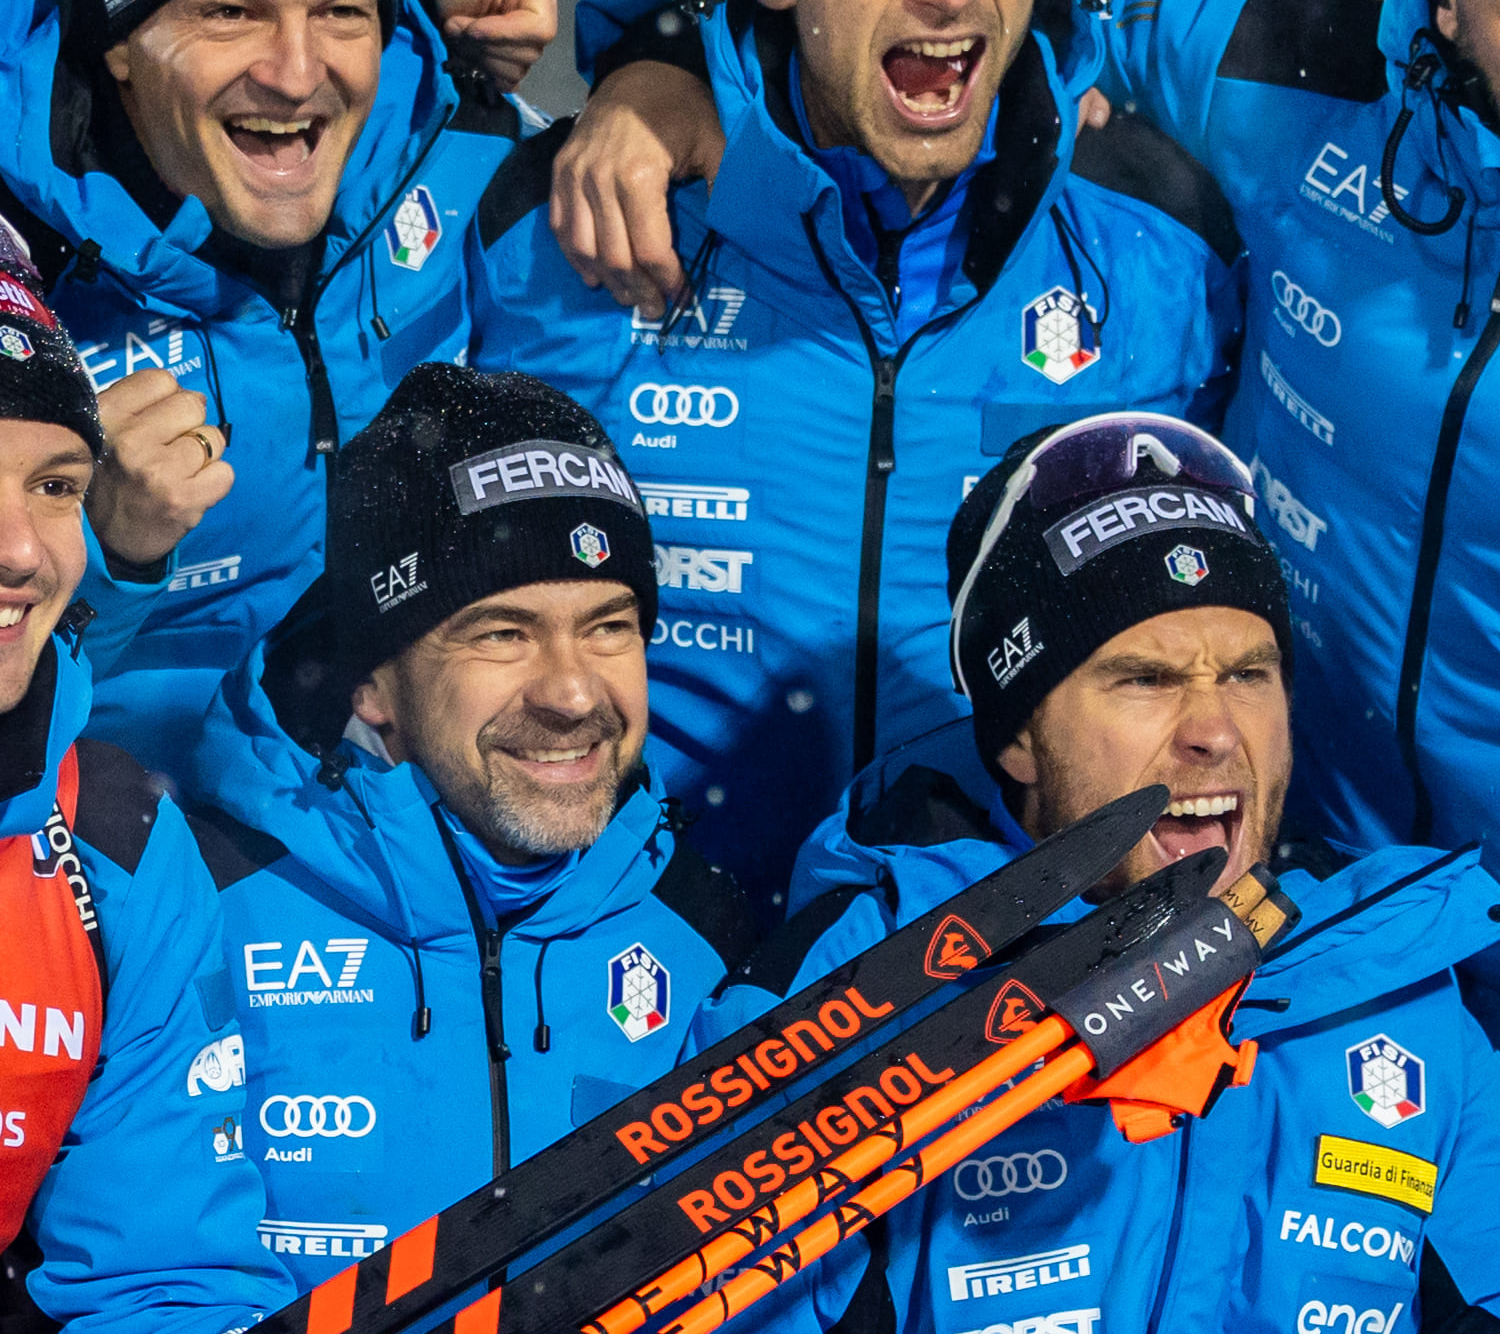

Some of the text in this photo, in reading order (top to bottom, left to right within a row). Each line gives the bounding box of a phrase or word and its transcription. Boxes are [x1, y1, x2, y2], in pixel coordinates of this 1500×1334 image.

[1305, 143, 1408, 223] EA7
[1034, 294, 1082, 321] FISI
[632, 432, 677, 449] Audi
[469, 448, 636, 504] FERCAM
[1060, 491, 1246, 558] FERCAM
[371, 552, 419, 604] EA7
[987, 616, 1032, 677] EA7
[244, 938, 368, 992] EA7
[622, 950, 660, 976] FISI
[249, 988, 373, 1007] EMPORIO ARMANI
[617, 986, 895, 1164] ROSSIGNOL
[1359, 1041, 1406, 1066] FISI
[264, 1147, 312, 1162] Audi
[677, 1051, 955, 1232] ROSSIGNOL
[1322, 1151, 1435, 1199] Guardia di Finanza
[963, 1206, 1010, 1227] Audi
[948, 1243, 1090, 1301] PIRELLI
